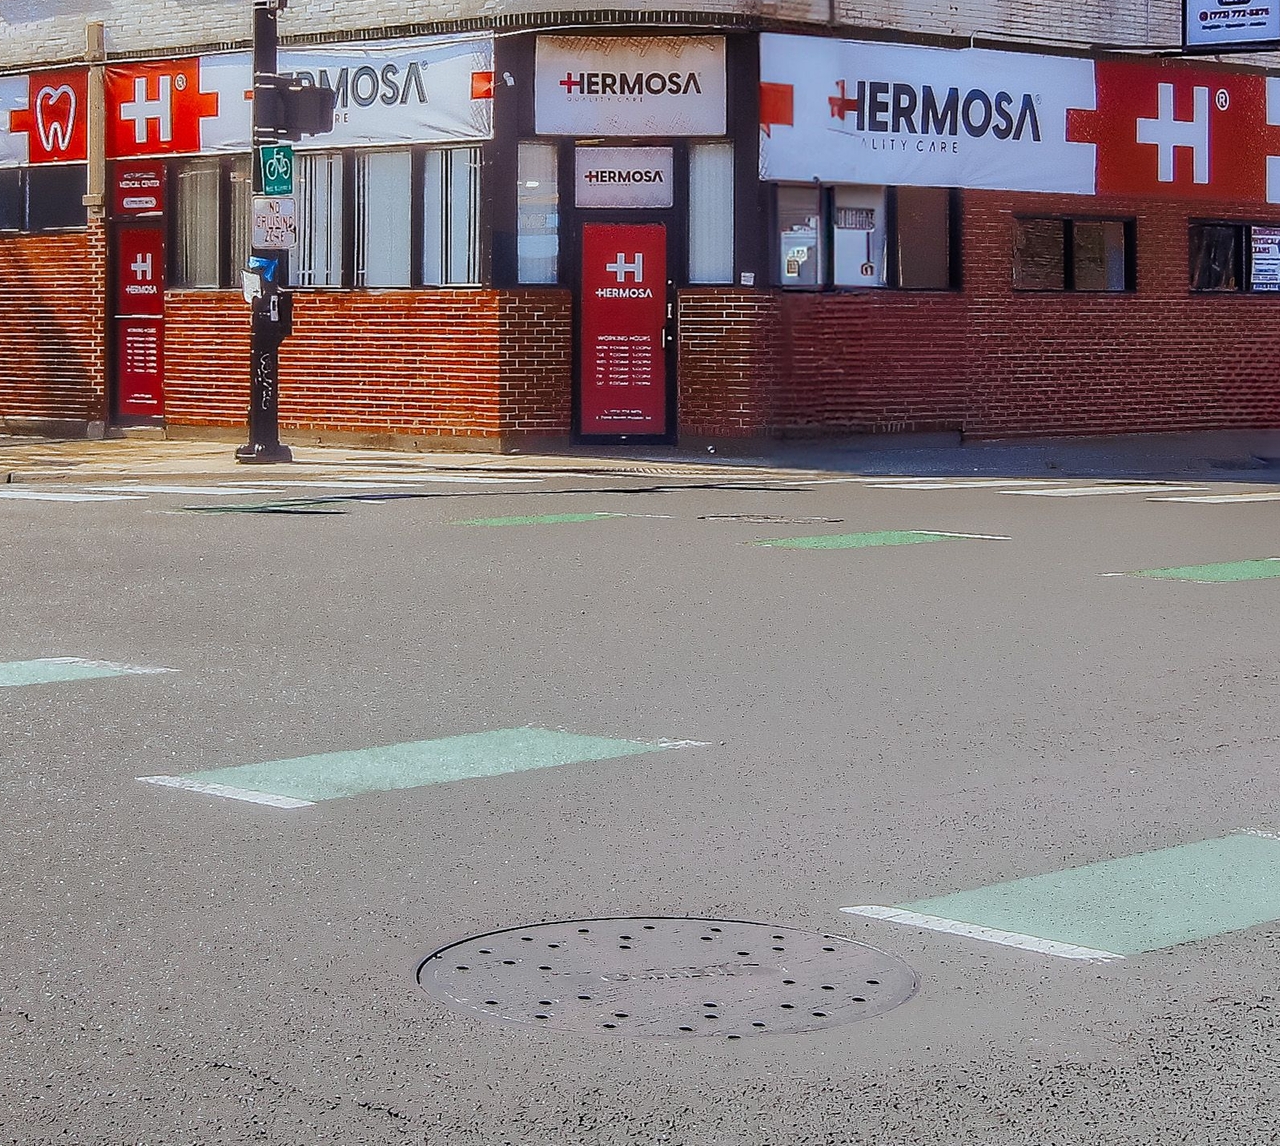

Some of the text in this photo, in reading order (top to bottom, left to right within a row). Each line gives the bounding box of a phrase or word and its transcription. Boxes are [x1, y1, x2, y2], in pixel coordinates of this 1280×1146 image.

[279, 61, 429, 109] MOSA
[559, 71, 702, 95] HERMOSA
[828, 79, 1042, 142] HERMOSA
[916, 139, 959, 154] CARE
[584, 170, 664, 183] HERMOSA
[269, 201, 280, 213] NO
[257, 215, 294, 229] CRUISING
[264, 229, 286, 243] ZONE
[125, 284, 157, 294] HERMOSA
[595, 288, 653, 299] HERMOSA
